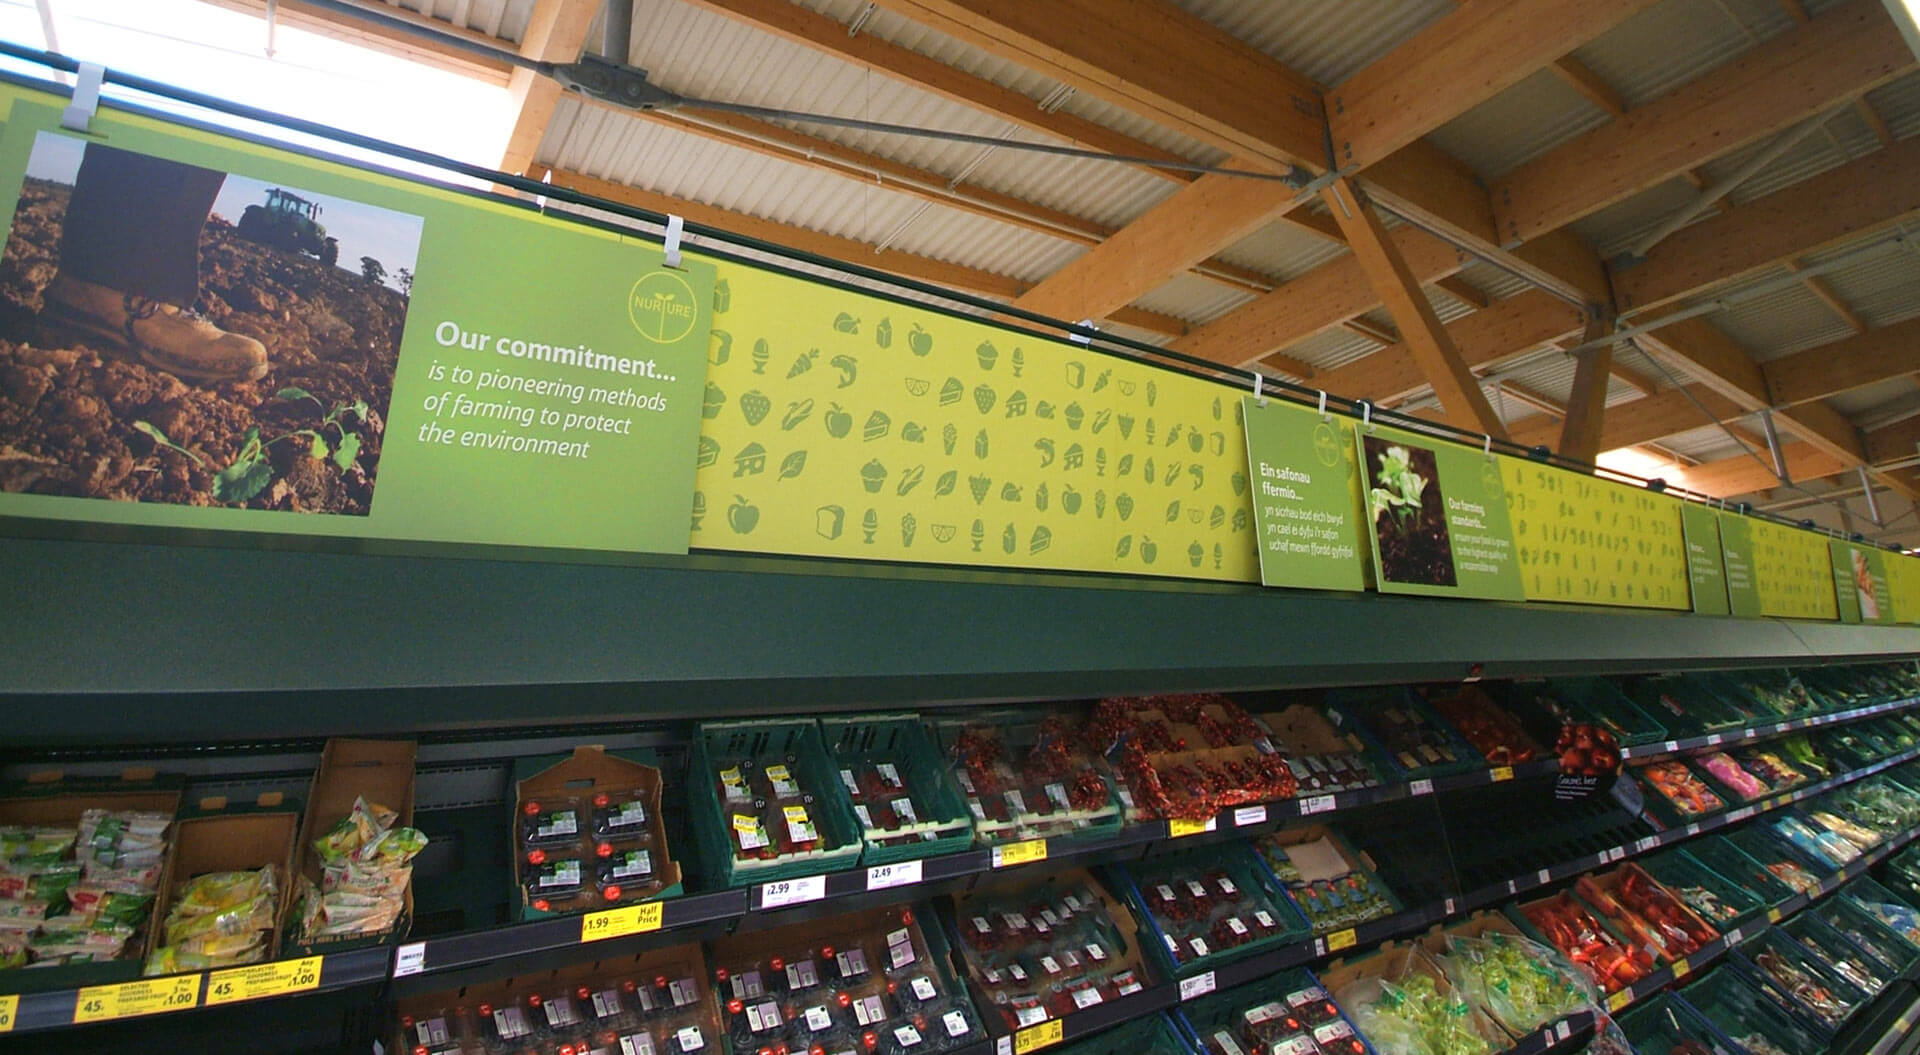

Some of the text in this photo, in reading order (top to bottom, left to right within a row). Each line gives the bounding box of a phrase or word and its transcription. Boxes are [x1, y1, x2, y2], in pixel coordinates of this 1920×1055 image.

[634, 293, 691, 318] NURTURE
[436, 321, 676, 382] Our commitment...
[428, 360, 667, 412] is to pioneering methods
[424, 392, 632, 434] of farming to protect
[418, 422, 590, 458] the environment
[1260, 462, 1310, 484] Ein safonau
[1262, 481, 1304, 500] ffermio...
[1265, 506, 1274, 518] yn
[1300, 508, 1312, 520] bod
[1268, 524, 1276, 535] yn
[768, 883, 790, 896] £2.99
[640, 905, 657, 915] Half
[584, 916, 608, 930] £1.99
[638, 916, 658, 924] Price
[288, 974, 314, 986] £1.00
[162, 993, 192, 1006] £1.00
